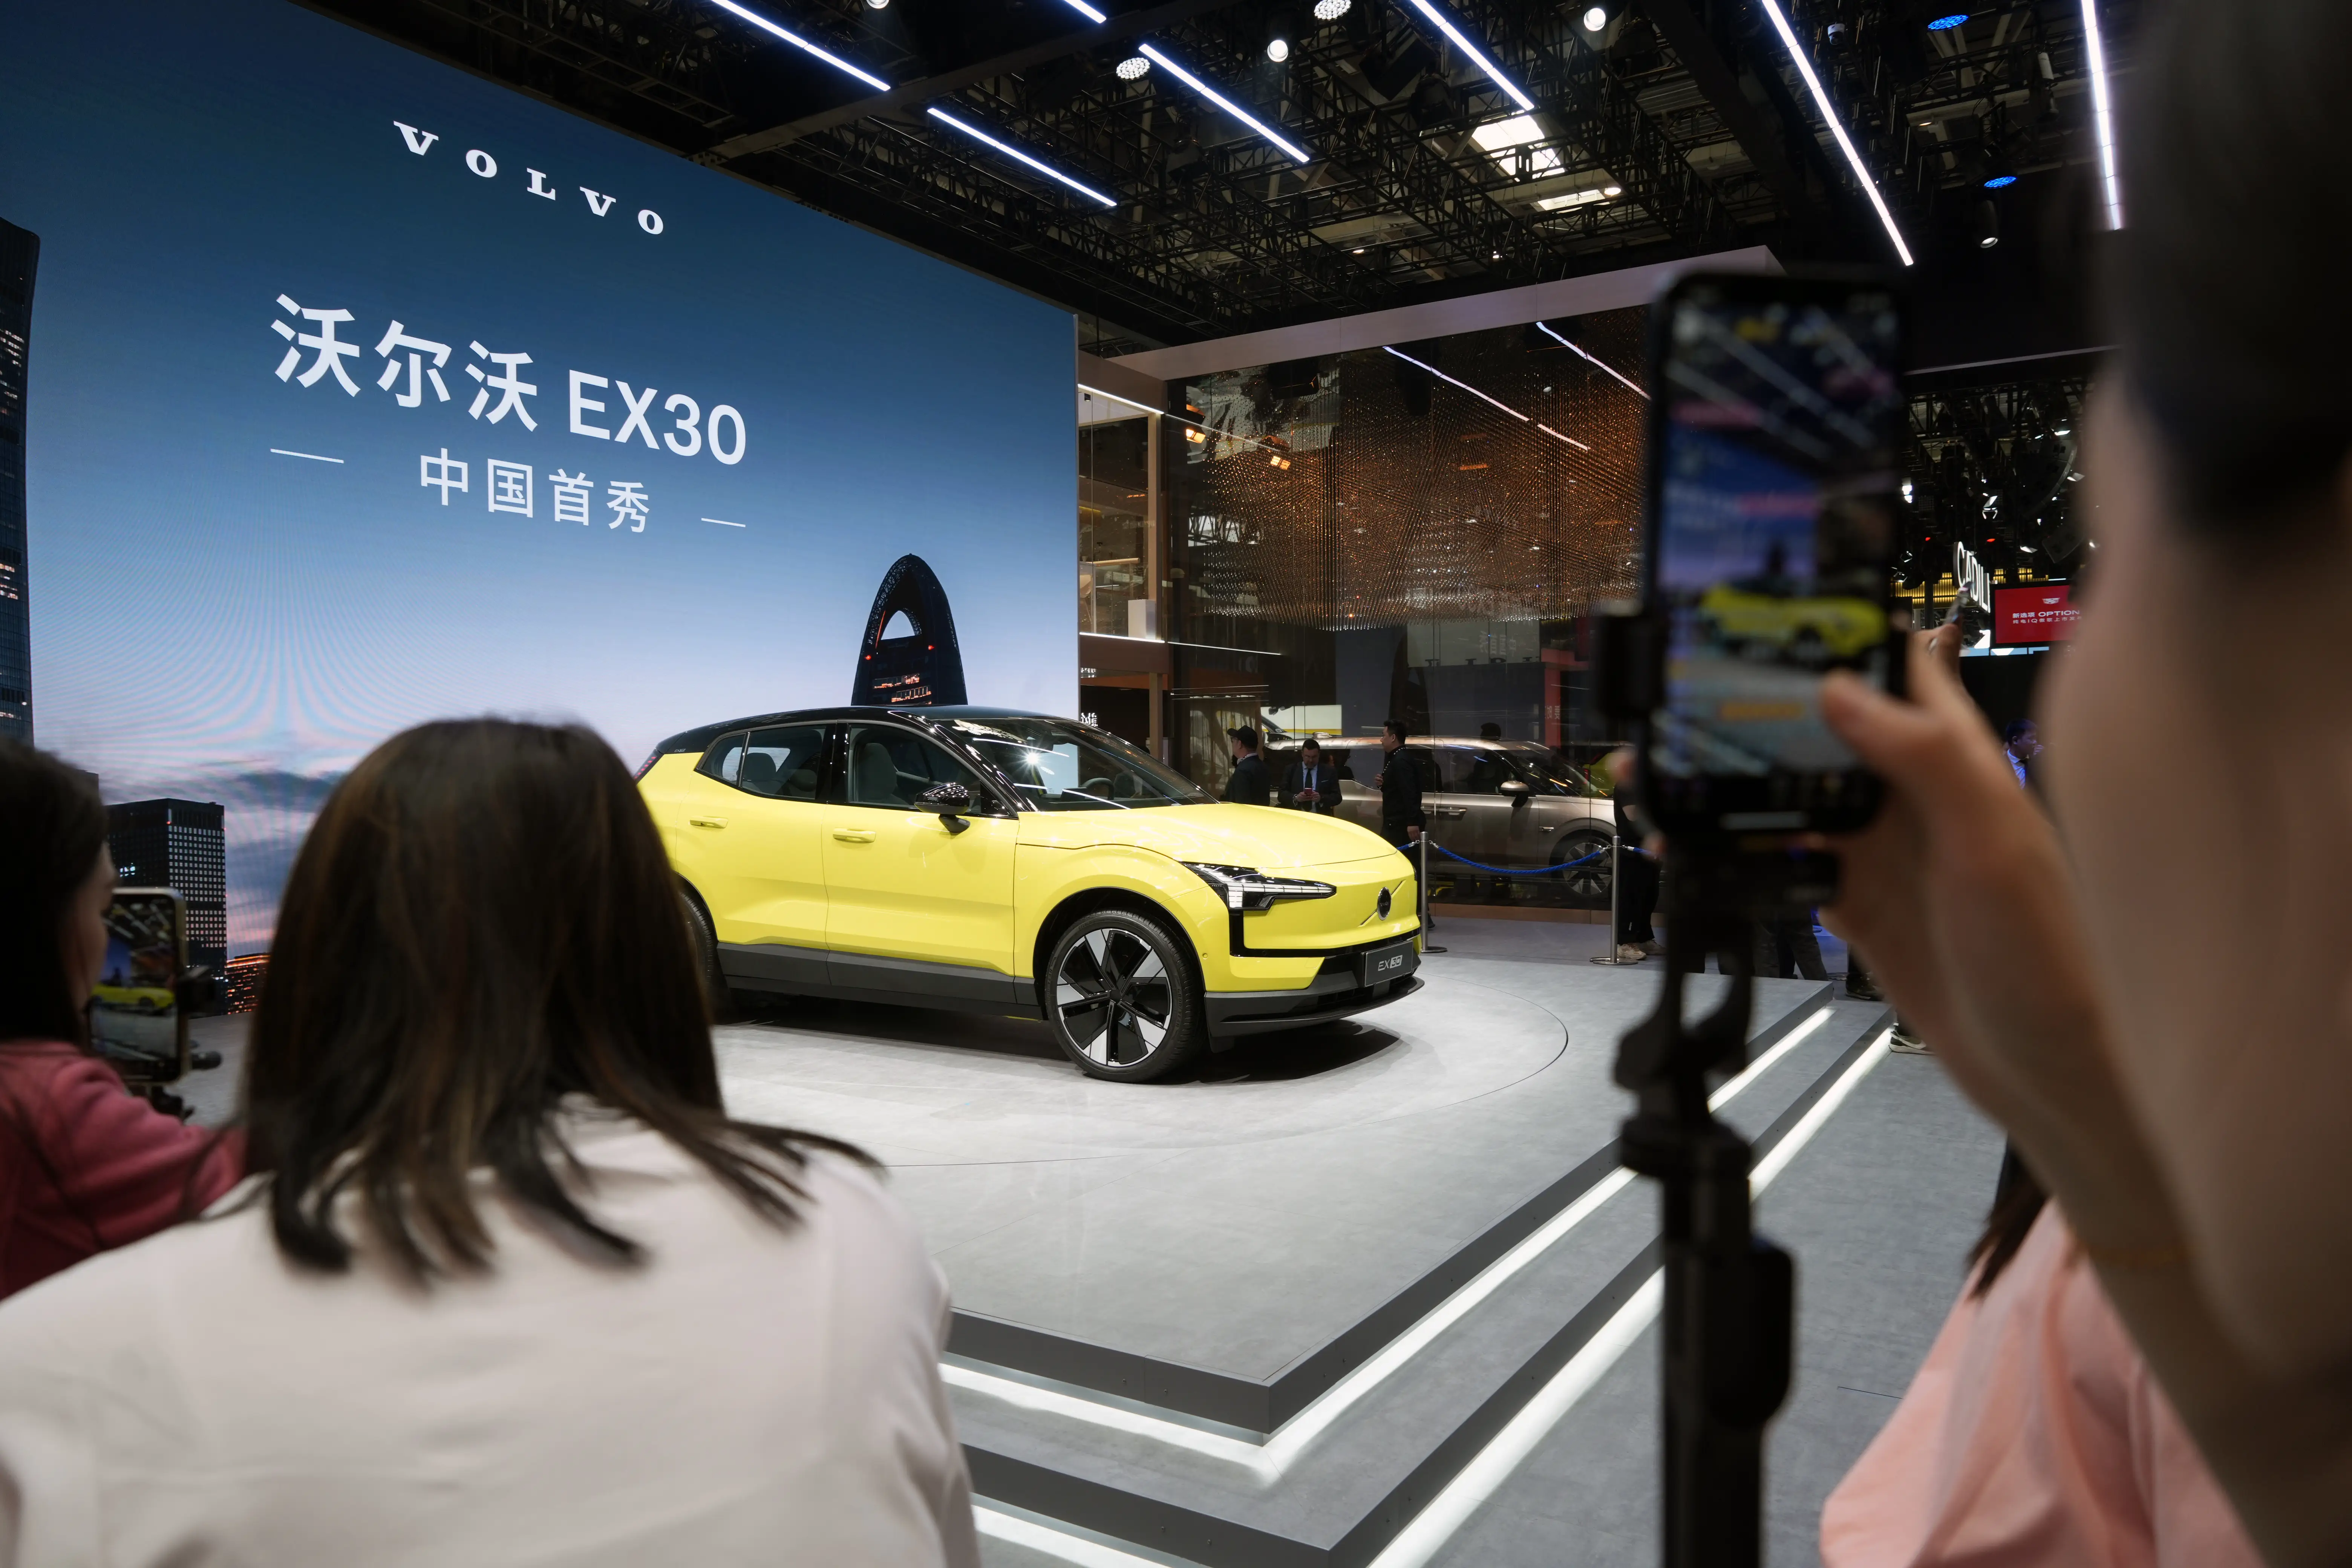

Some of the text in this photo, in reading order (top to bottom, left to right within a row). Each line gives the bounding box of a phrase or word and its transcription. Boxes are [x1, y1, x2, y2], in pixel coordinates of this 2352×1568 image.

[394, 121, 664, 234] VOLVO
[271, 294, 746, 465] 沃尔沃 EX30
[420, 448, 650, 533] 中国首秀
[1378, 954, 1403, 971] EX30
